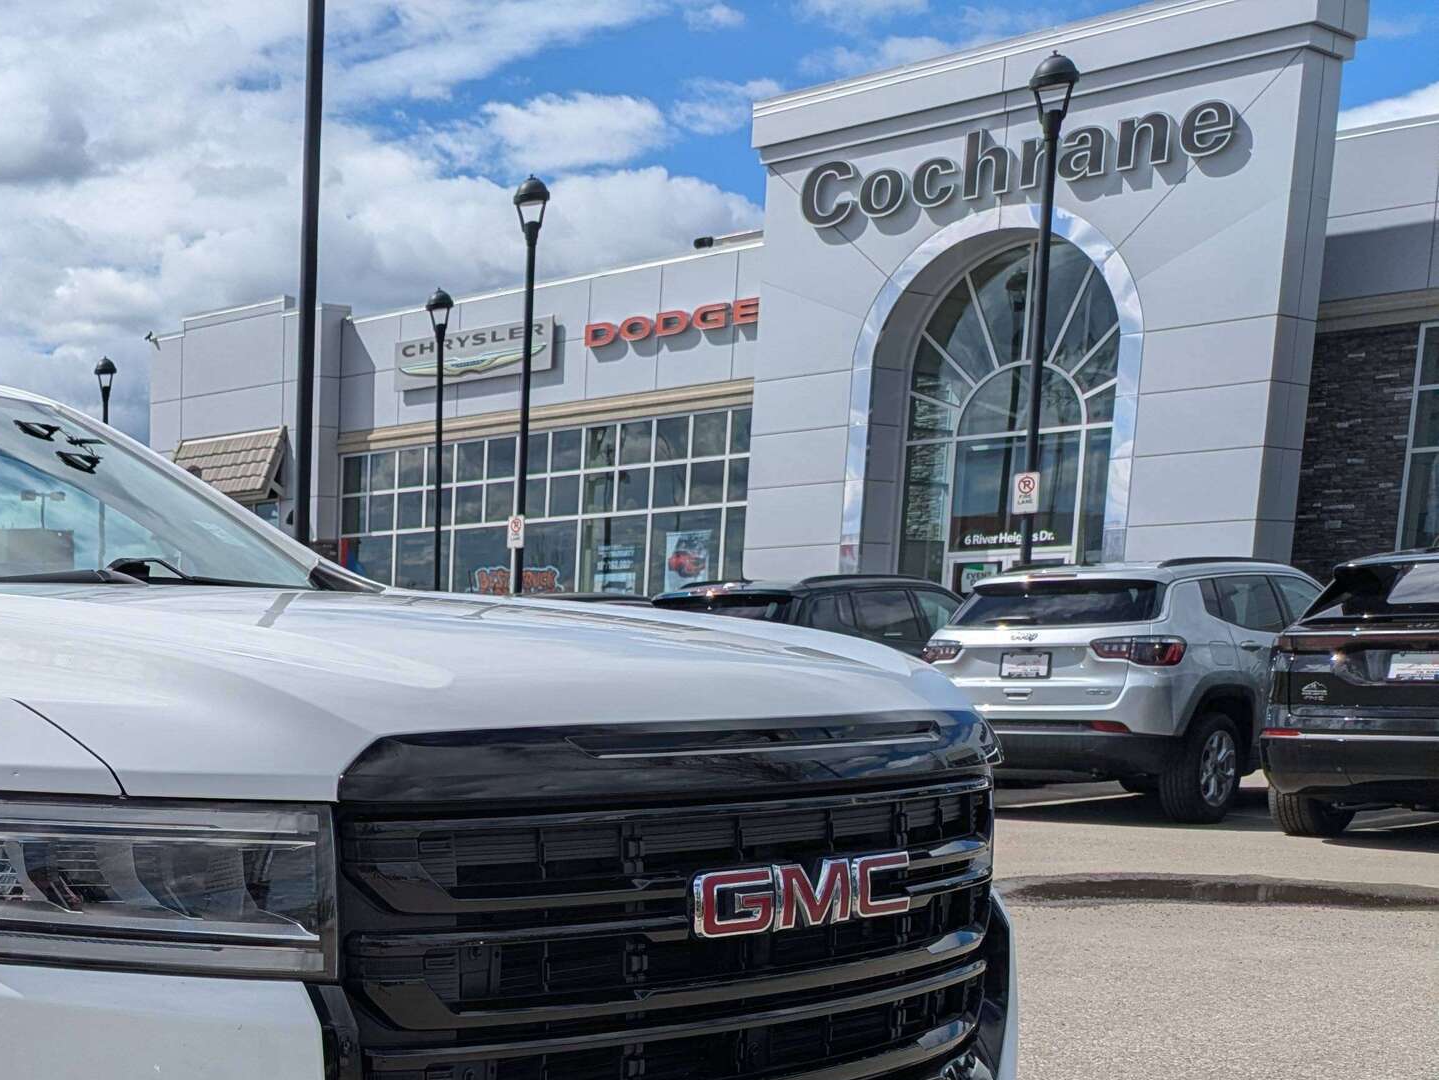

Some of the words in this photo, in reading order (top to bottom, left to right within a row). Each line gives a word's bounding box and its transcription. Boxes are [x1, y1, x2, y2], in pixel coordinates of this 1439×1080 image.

[799, 99, 1235, 228] Cochrane
[402, 323, 544, 358] CHRYSLER
[584, 297, 759, 348] DODGE
[964, 534, 971, 545] 6
[972, 534, 998, 545] River
[999, 531, 1038, 545] Heigs
[1040, 530, 1055, 541] Dr.
[693, 851, 910, 938] GMC
